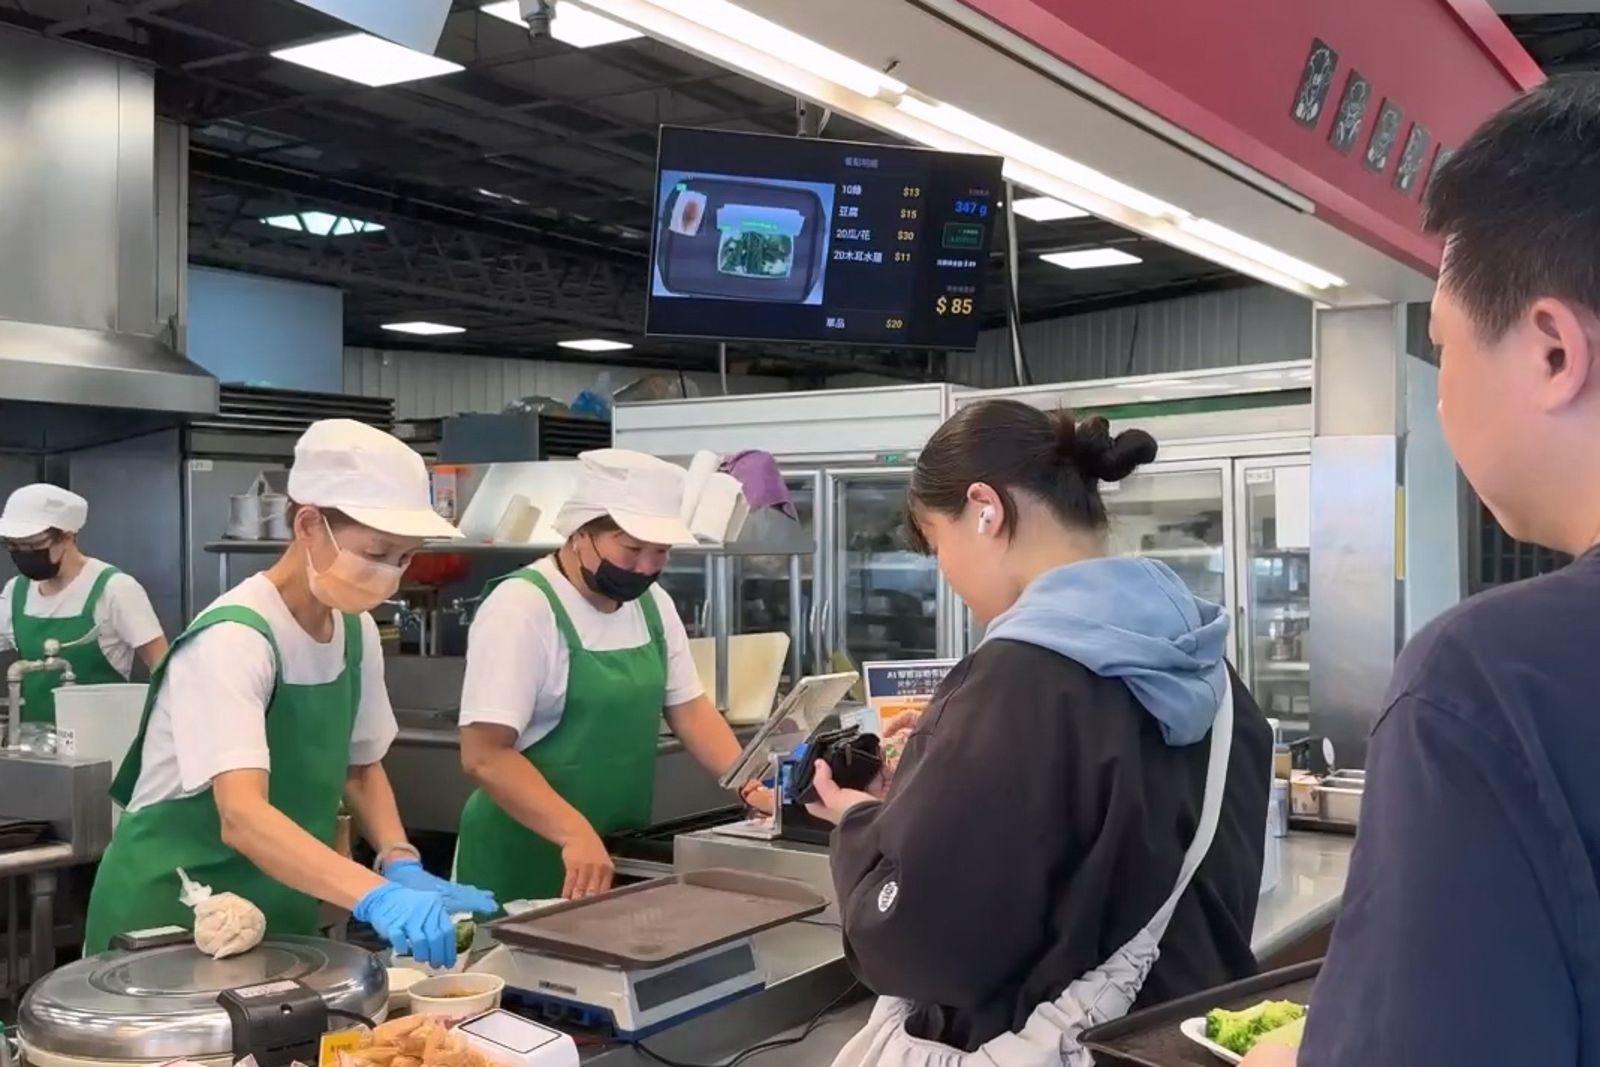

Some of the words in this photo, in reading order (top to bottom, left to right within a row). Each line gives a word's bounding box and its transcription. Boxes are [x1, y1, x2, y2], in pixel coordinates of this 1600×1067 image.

[903, 187, 920, 197] $13
[900, 209, 917, 219] $15
[954, 201, 977, 214] 347
[979, 205, 988, 217] g
[897, 230, 914, 240] $30
[894, 252, 911, 262] $11
[951, 298, 973, 314] 85
[885, 319, 903, 328] $20
